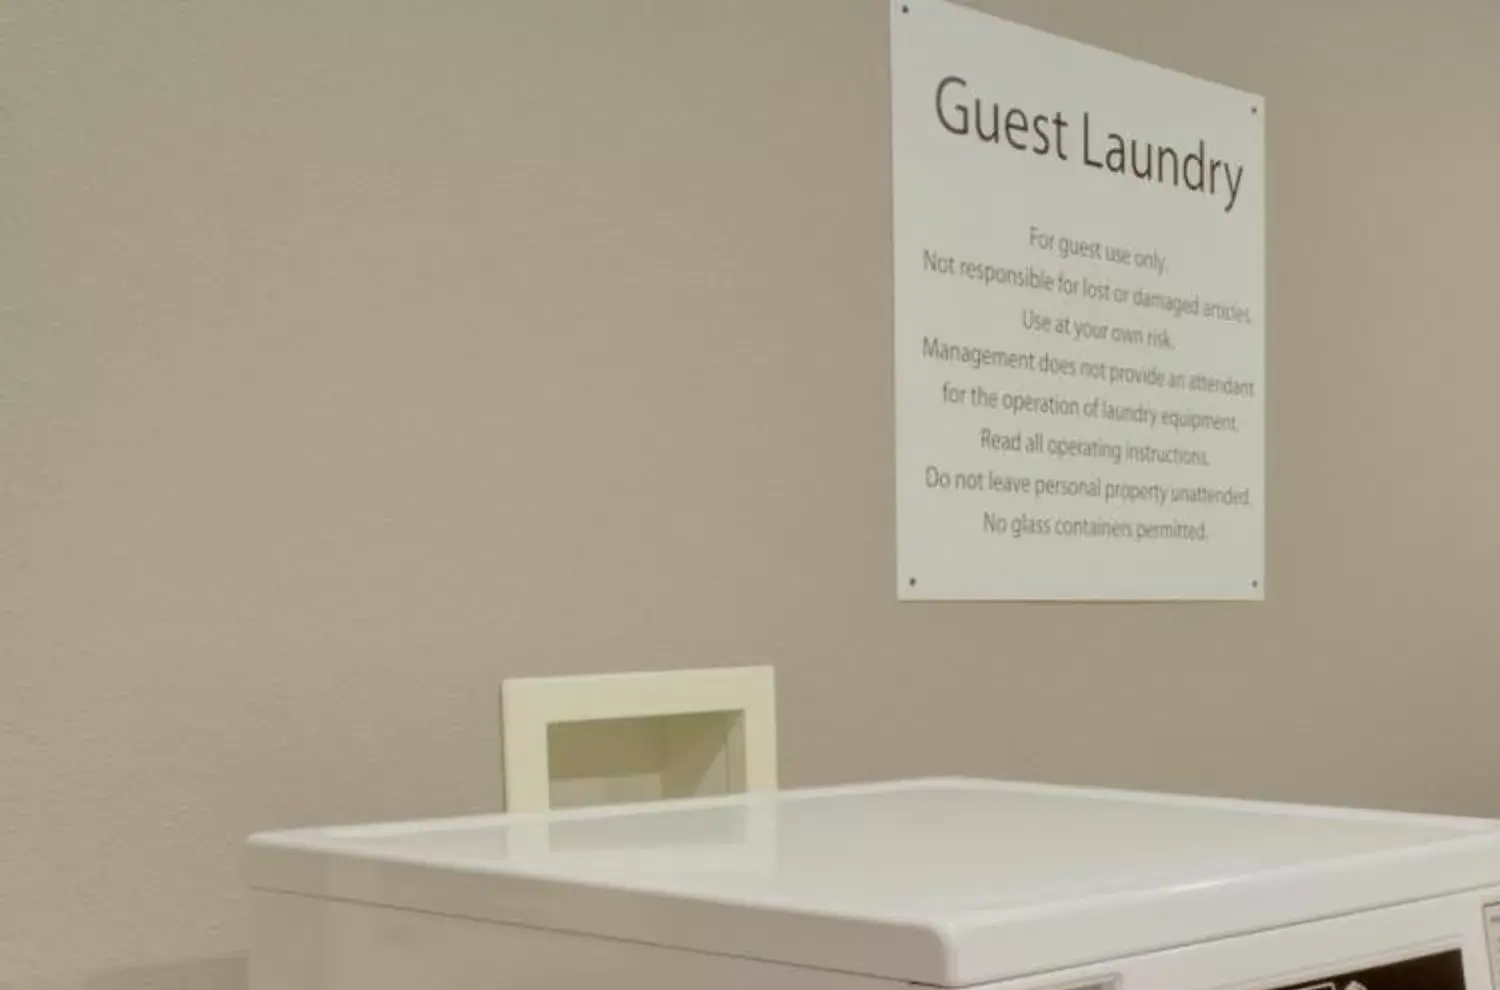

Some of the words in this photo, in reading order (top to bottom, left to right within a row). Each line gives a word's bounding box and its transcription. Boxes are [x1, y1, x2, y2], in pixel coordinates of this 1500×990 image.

[935, 75, 1069, 162] Guest
[1082, 111, 1244, 213] Laundry
[1029, 226, 1055, 250] For
[1059, 234, 1101, 260] guest
[1105, 247, 1131, 267] use
[1134, 250, 1168, 276] only.
[923, 249, 955, 274] Not
[959, 260, 1054, 292] responsible
[1057, 275, 1079, 295] for
[1083, 277, 1110, 301] lost
[1112, 287, 1129, 303] or
[1133, 287, 1199, 318] damaged
[1203, 301, 1252, 325] articles.
[1023, 309, 1051, 333] Use
[1055, 316, 1071, 335] at
[1073, 321, 1108, 342] your
[1111, 326, 1143, 344] own
[1147, 329, 1176, 350] risk.
[922, 336, 1036, 369] Management
[1039, 352, 1076, 376] does
[1080, 360, 1106, 381] not
[1109, 362, 1165, 388] provide
[1168, 372, 1185, 388] an
[1188, 373, 1255, 397] attendant
[942, 381, 967, 404] for
[970, 385, 998, 409] the
[1001, 391, 1080, 416] operation
[1082, 397, 1100, 418] of
[1101, 400, 1157, 428] laundry
[1161, 410, 1239, 433] equipment.
[980, 428, 1021, 453] Read
[1024, 432, 1044, 454] all
[1046, 437, 1122, 465] operating
[1125, 443, 1210, 466] instructions.
[926, 466, 951, 489] Do
[955, 471, 984, 491] not
[988, 471, 1031, 493] leave
[1035, 476, 1101, 499] personal
[1104, 482, 1167, 507] property
[1171, 485, 1252, 506] unattended.
[983, 511, 1007, 534] No
[1011, 513, 1051, 538] glass
[1054, 516, 1133, 538] containers
[1136, 521, 1208, 542] permitted.
